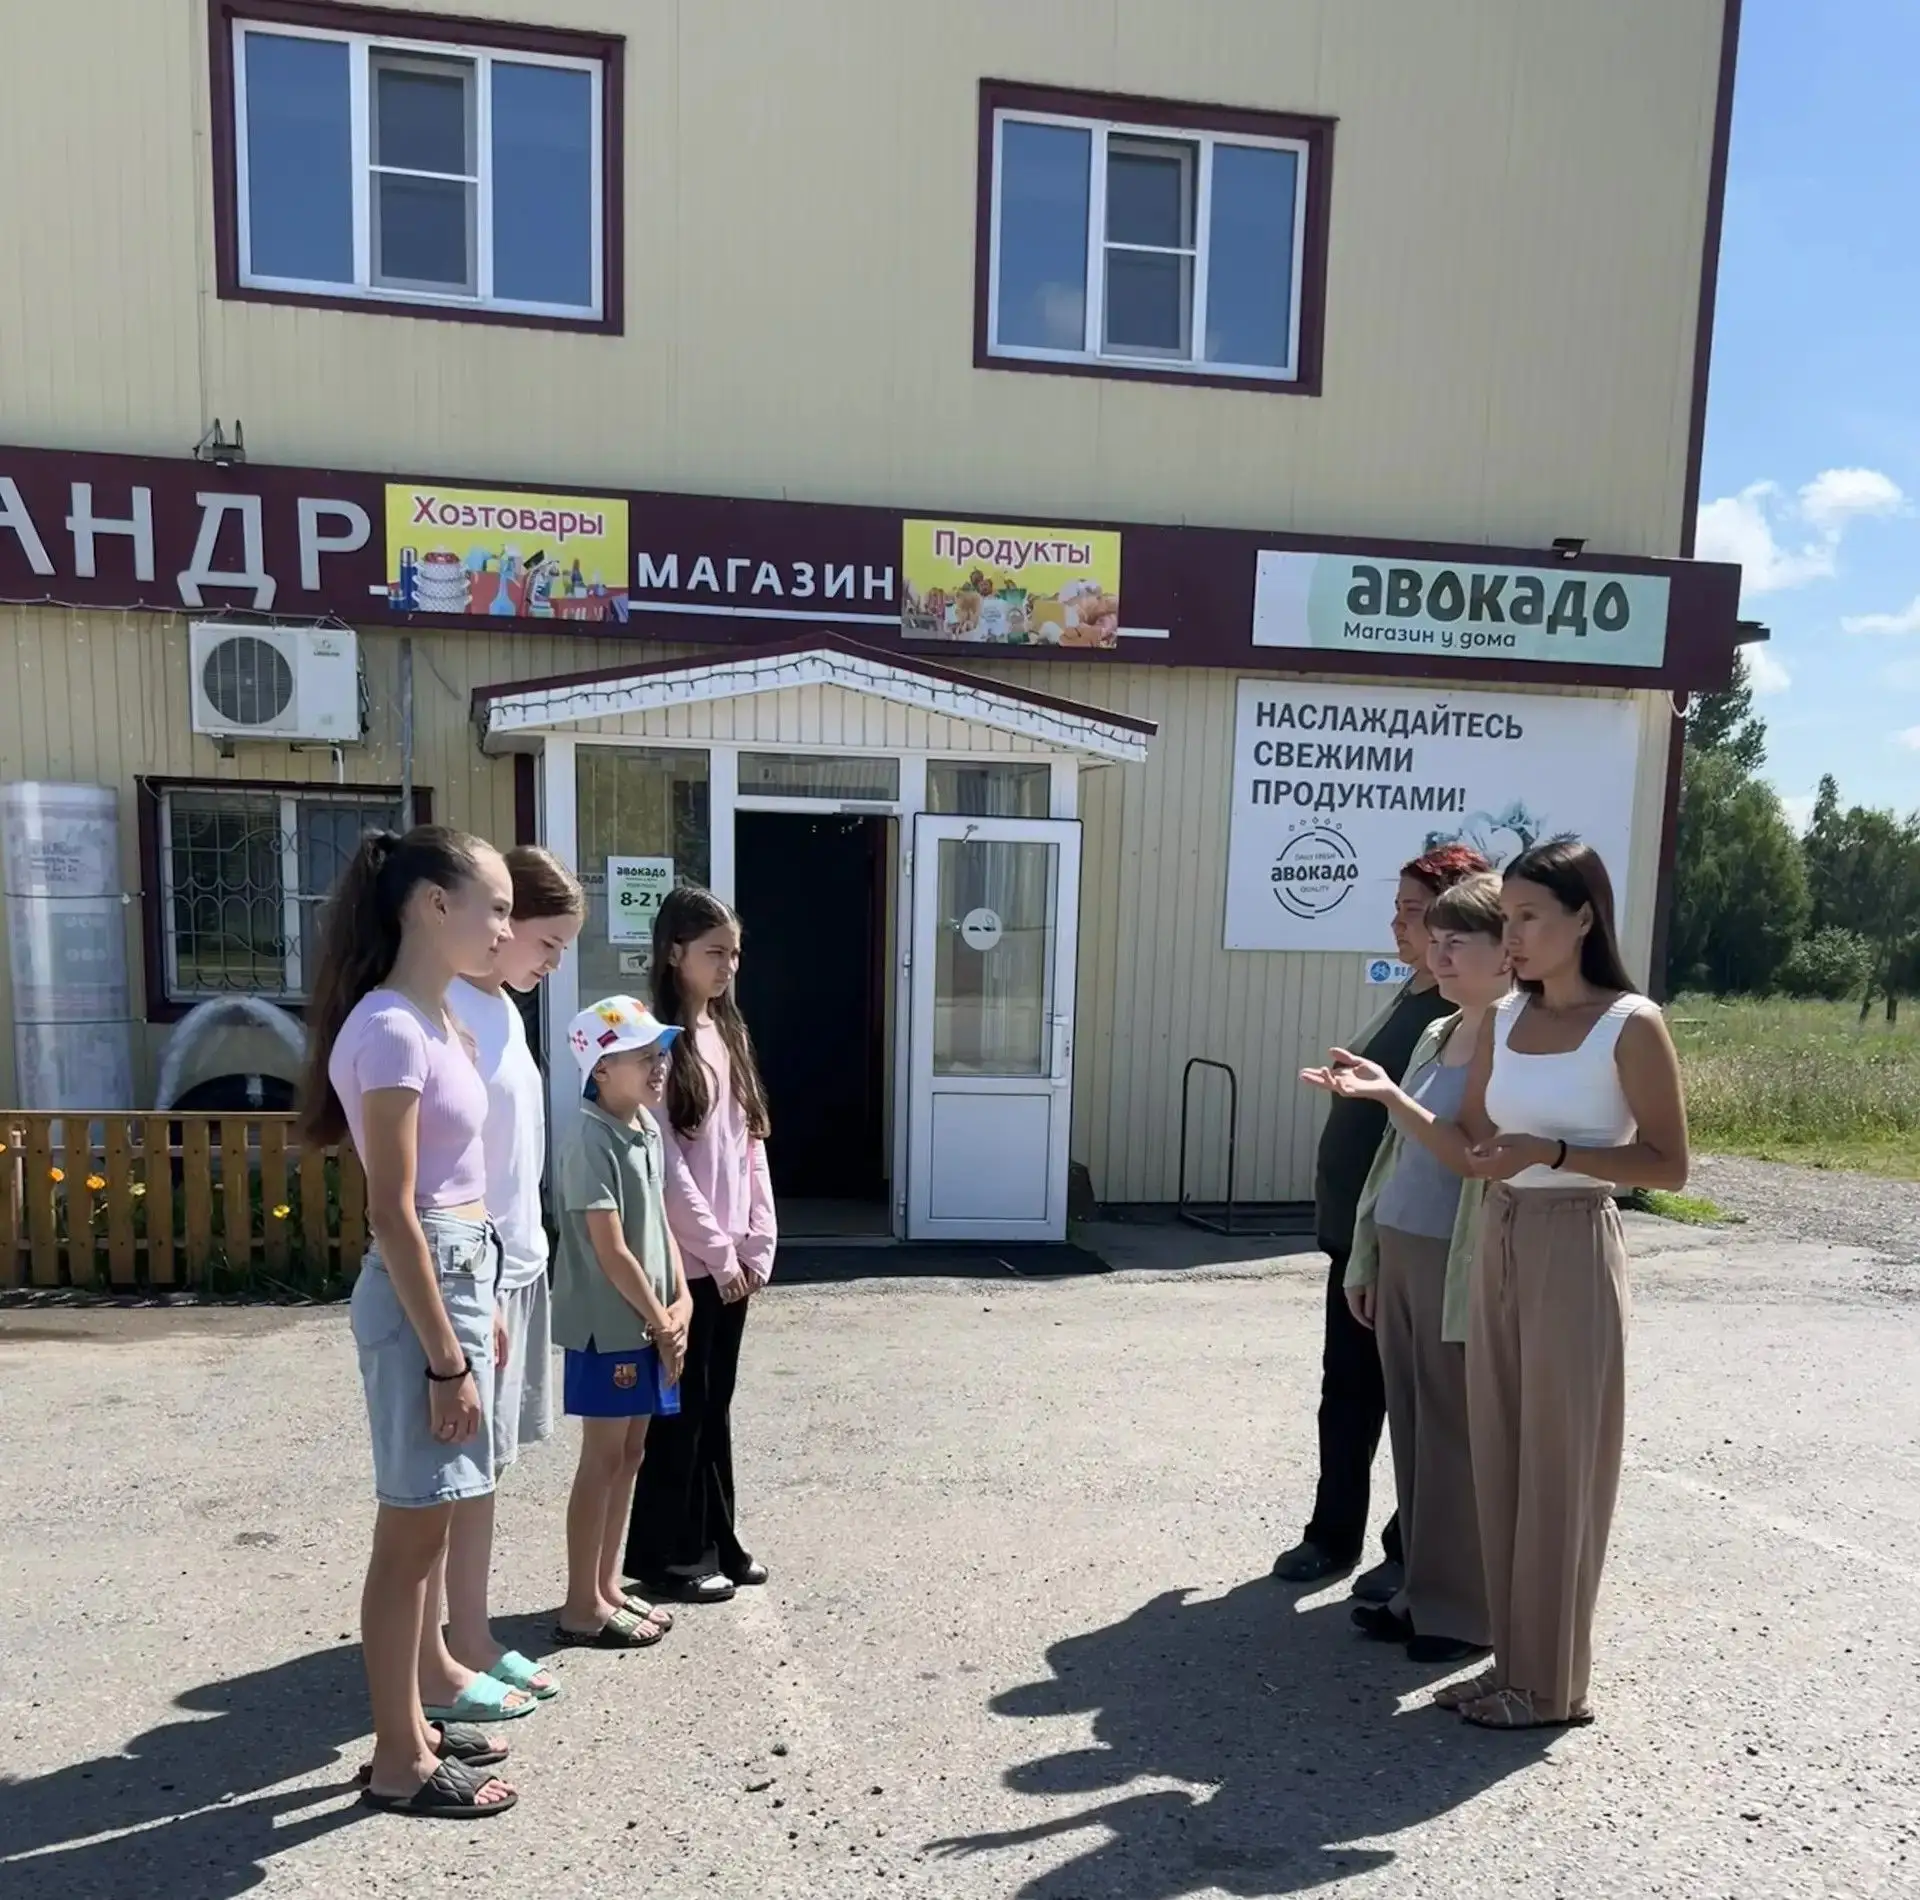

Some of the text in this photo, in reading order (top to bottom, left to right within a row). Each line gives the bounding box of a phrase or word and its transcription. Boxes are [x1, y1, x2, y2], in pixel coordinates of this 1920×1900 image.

[413, 496, 605, 540] Хозтовары
[935, 530, 1090, 567] Продукты
[638, 552, 893, 600] МАГАЗИН
[1347, 565, 1630, 637] авокадо
[1344, 621, 1516, 648] Магазин у дома
[1256, 701, 1524, 739] НАСЛАЖДАЙТЕСЬ
[1254, 741, 1413, 772] СВЕЖИМИ
[1252, 779, 1466, 812] ПРОДУКТАМИ!
[616, 866, 666, 878] авокадо
[1271, 863, 1358, 882] авокадо
